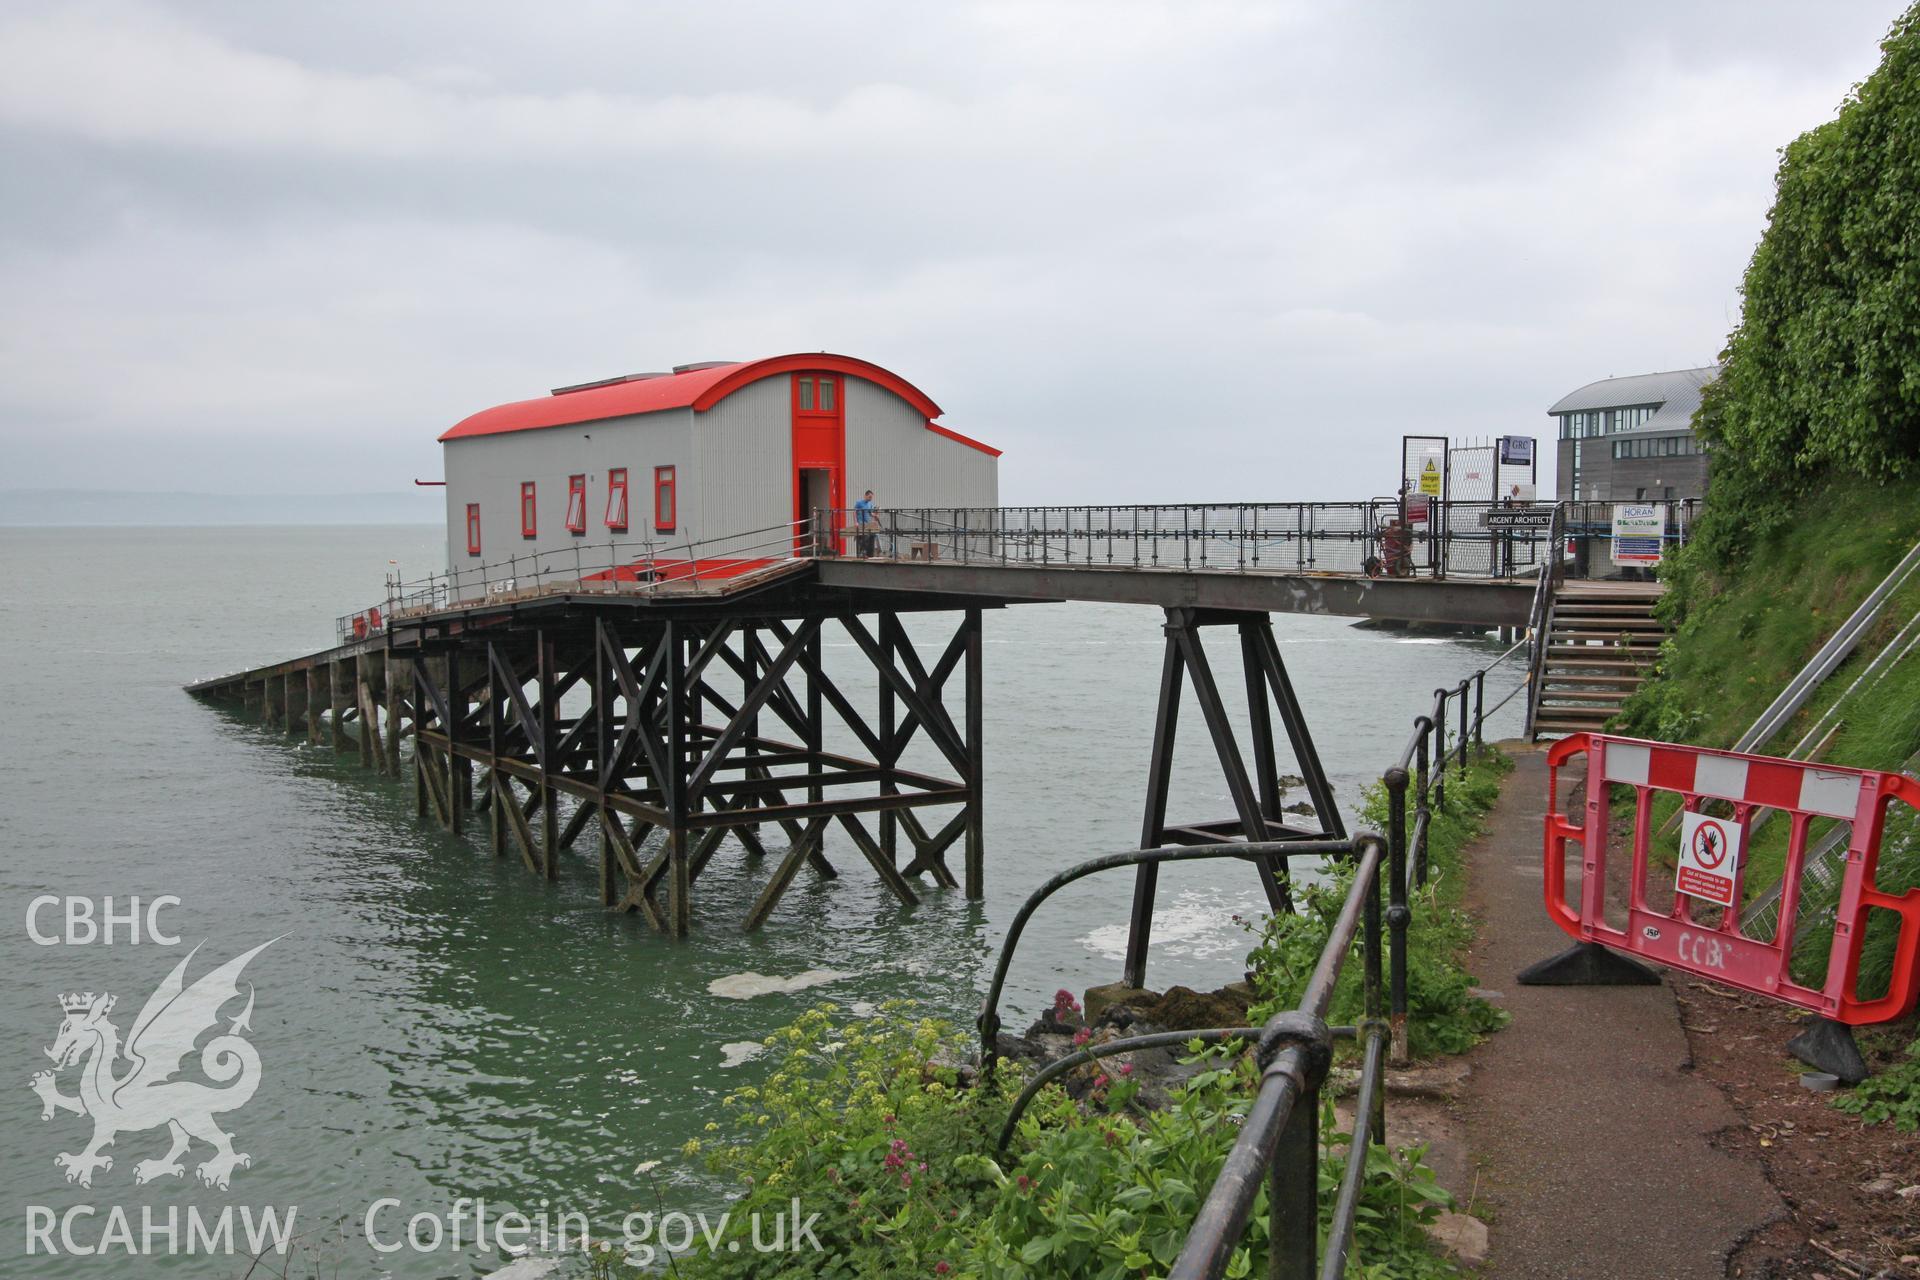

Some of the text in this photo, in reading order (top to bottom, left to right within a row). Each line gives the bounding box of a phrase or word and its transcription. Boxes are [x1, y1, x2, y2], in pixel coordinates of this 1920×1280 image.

[1512, 440, 1529, 450] GRC
[1624, 508, 1654, 516] HORAN
[1646, 928, 1658, 938] JSP
